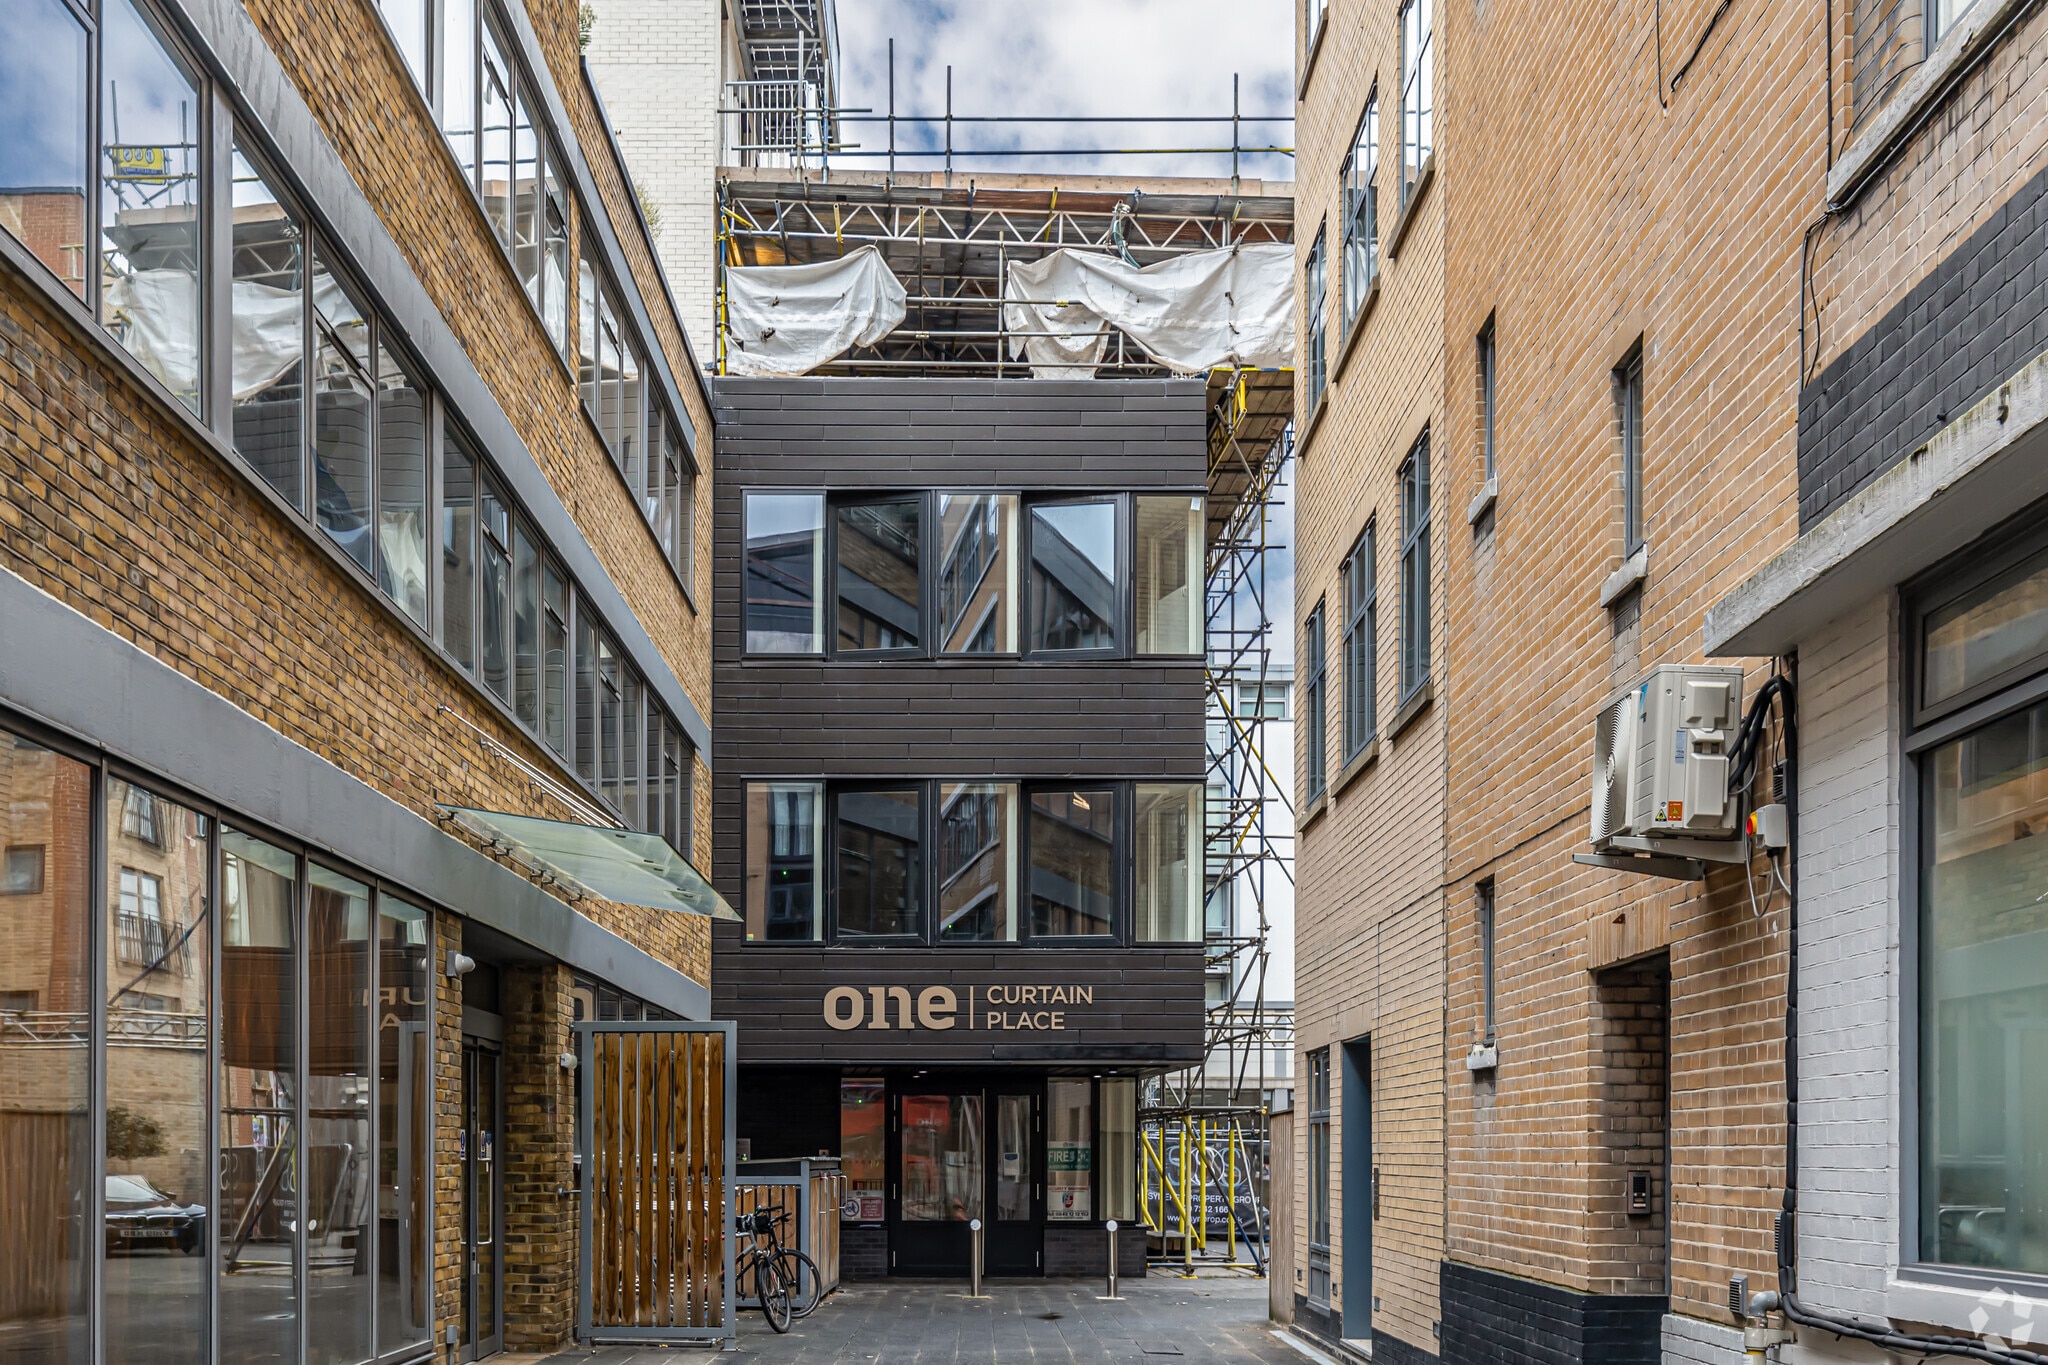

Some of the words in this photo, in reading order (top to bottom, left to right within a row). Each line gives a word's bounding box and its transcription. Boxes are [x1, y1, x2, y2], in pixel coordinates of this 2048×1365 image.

[987, 985, 1093, 1005] CURTAIN
[823, 986, 957, 1031] one
[987, 1011, 1065, 1030] PLACE
[1048, 1150, 1069, 1162] FIRE
